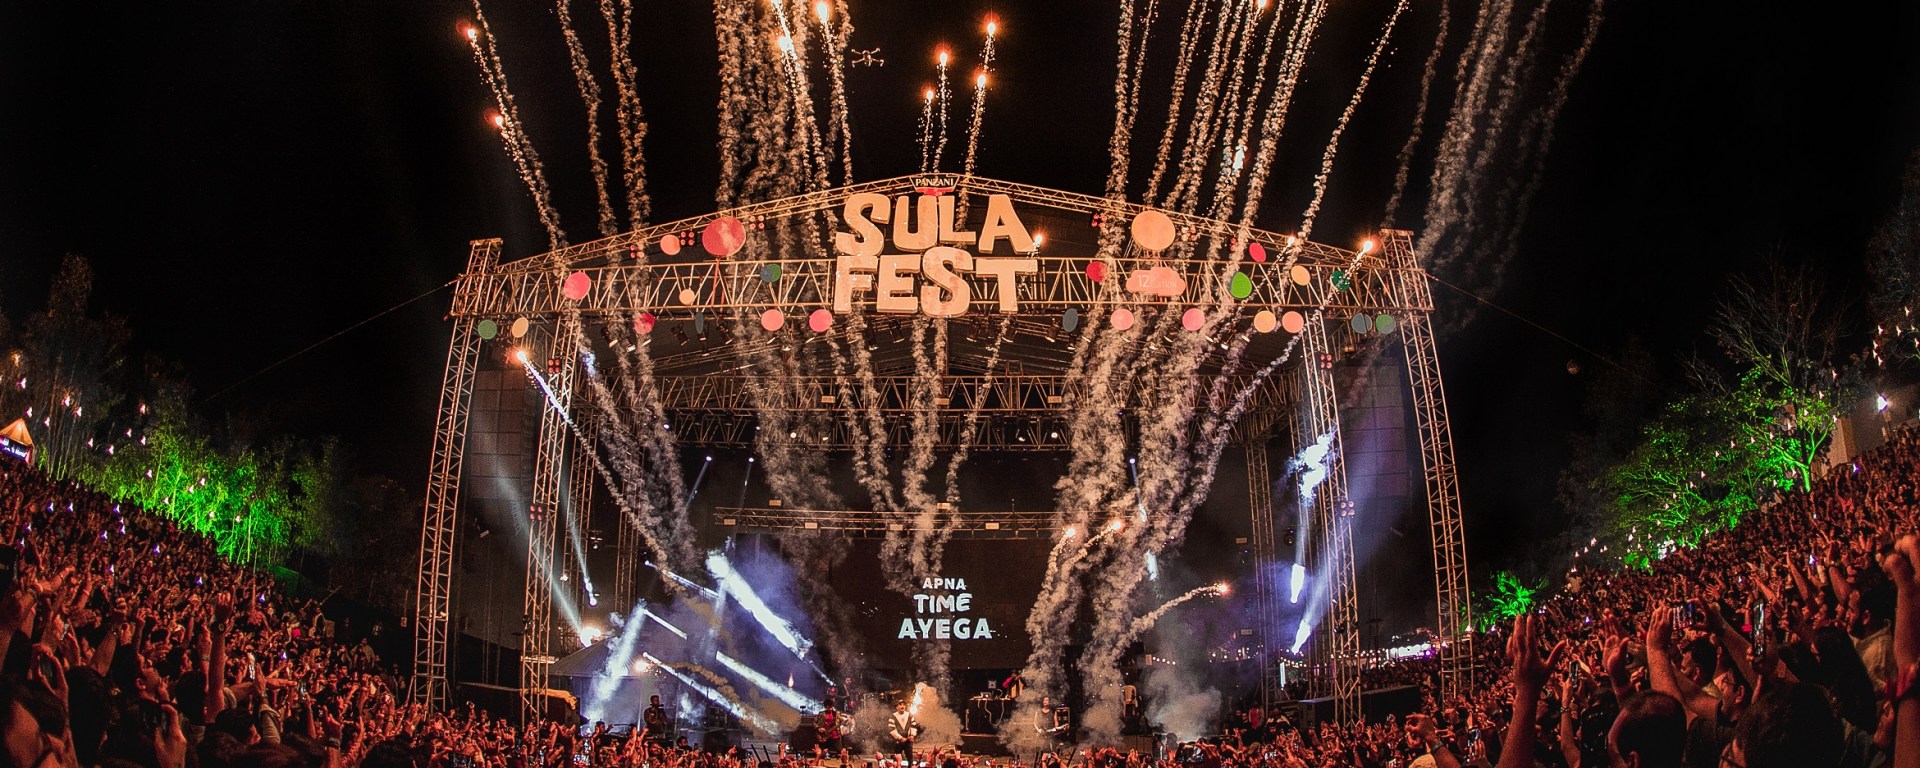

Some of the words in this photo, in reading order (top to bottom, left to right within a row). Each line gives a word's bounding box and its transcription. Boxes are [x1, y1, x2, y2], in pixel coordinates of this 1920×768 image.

[915, 178, 954, 187] PANZANI
[836, 192, 1038, 257] SULA
[833, 246, 1039, 318] FEST
[922, 577, 967, 590] APNA
[913, 593, 973, 614] TIME
[897, 617, 993, 640] AYEGA
